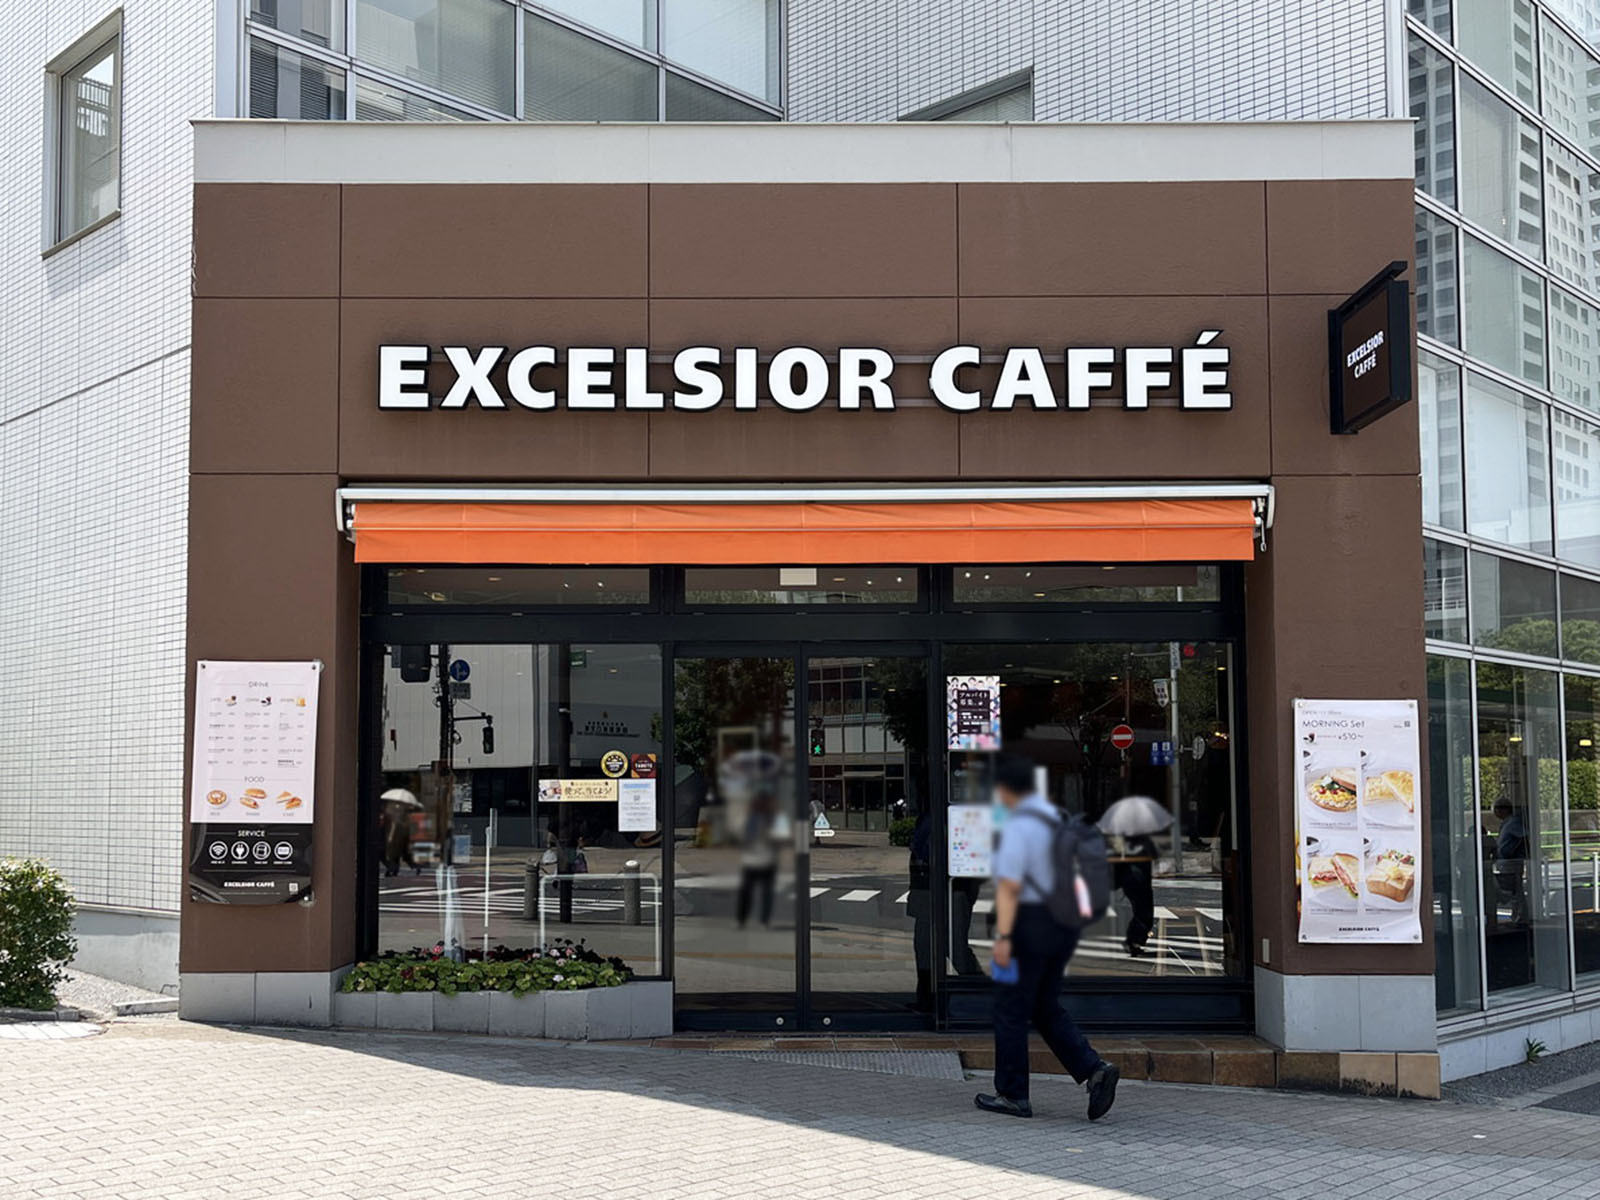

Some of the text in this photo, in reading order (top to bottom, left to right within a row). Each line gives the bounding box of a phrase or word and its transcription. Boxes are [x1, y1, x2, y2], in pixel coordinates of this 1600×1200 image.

[1347, 331, 1384, 367] EXCELSIOR
[379, 331, 1232, 409] EXCELSIOR CAFFÉ
[1354, 352, 1377, 378] CAFFÉ
[1303, 720, 1365, 728] MORNING Set
